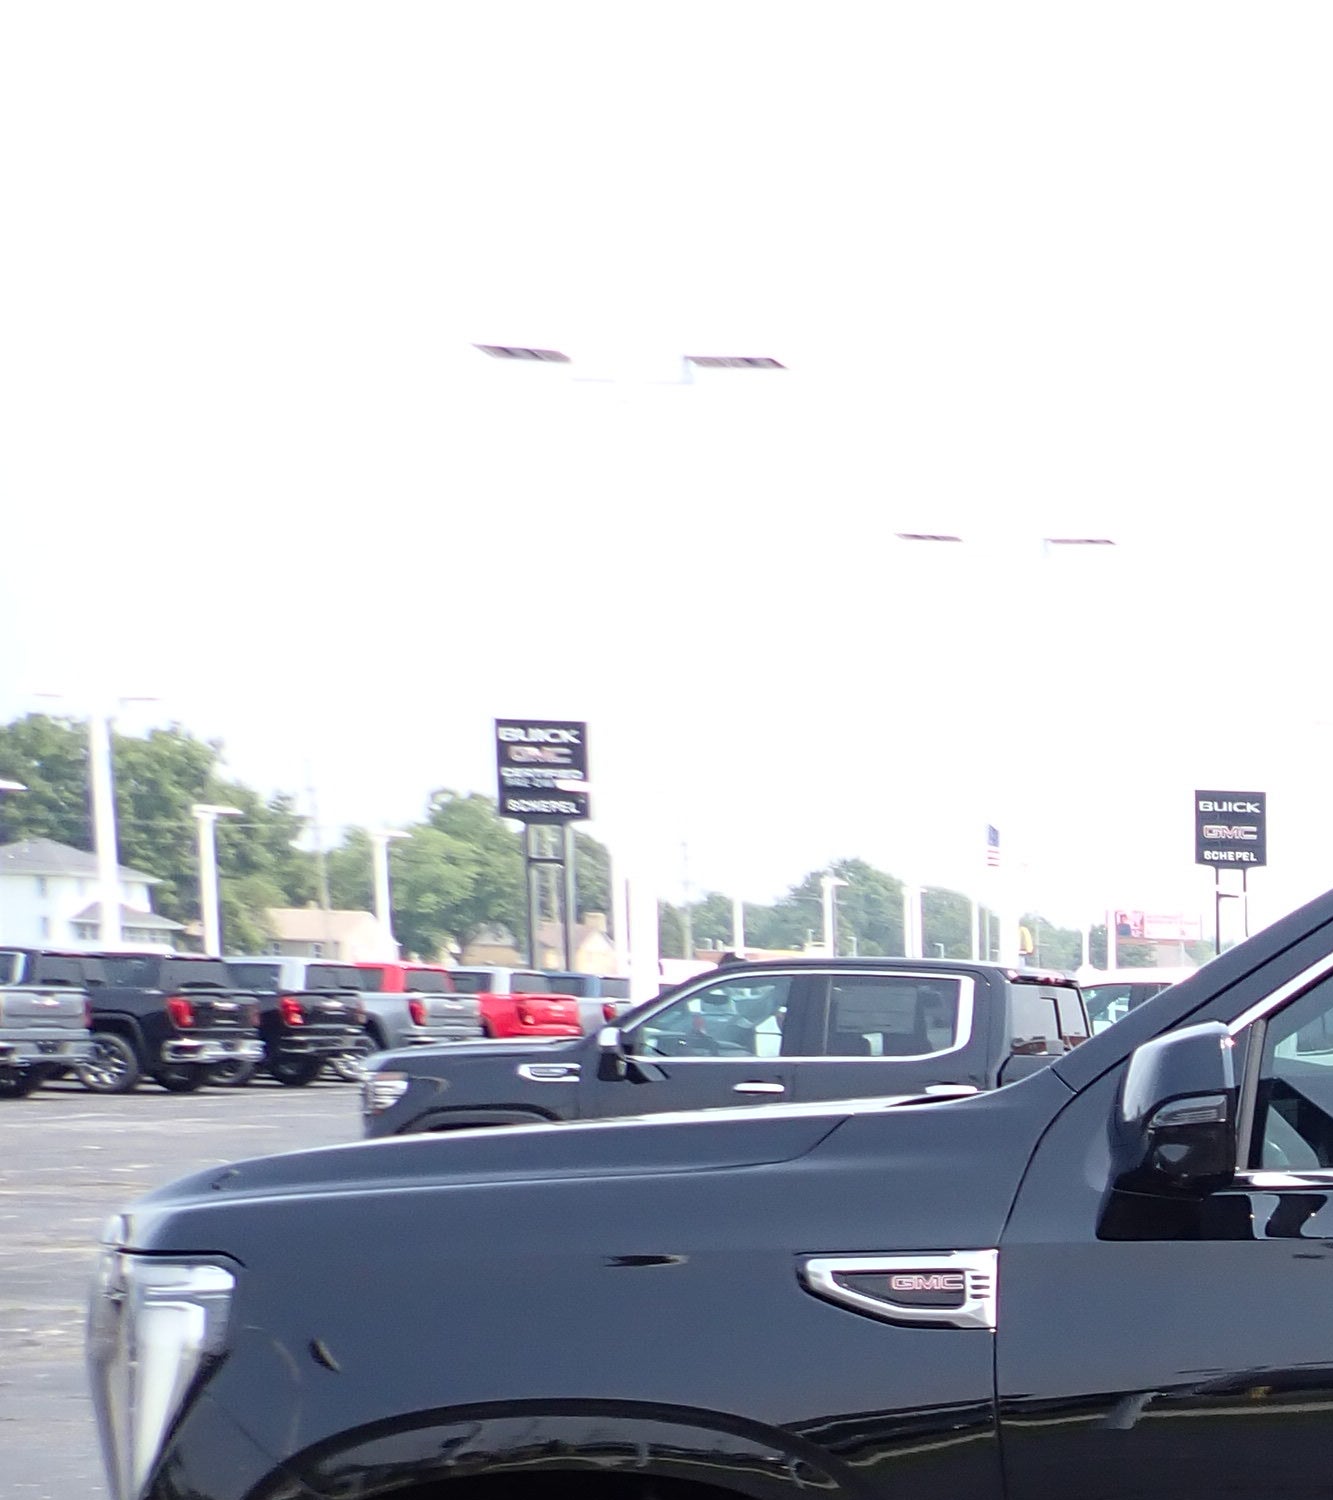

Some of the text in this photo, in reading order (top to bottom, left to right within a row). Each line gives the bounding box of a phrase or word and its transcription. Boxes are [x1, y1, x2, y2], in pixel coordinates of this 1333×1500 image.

[498, 727, 581, 744] BUICK
[508, 745, 572, 763] GMC
[507, 798, 581, 814] SCHEPEL
[1199, 800, 1261, 813] BUICK
[1203, 824, 1257, 840] GMC
[1203, 850, 1257, 861] SCHEPEL
[891, 1274, 964, 1290] GMC
